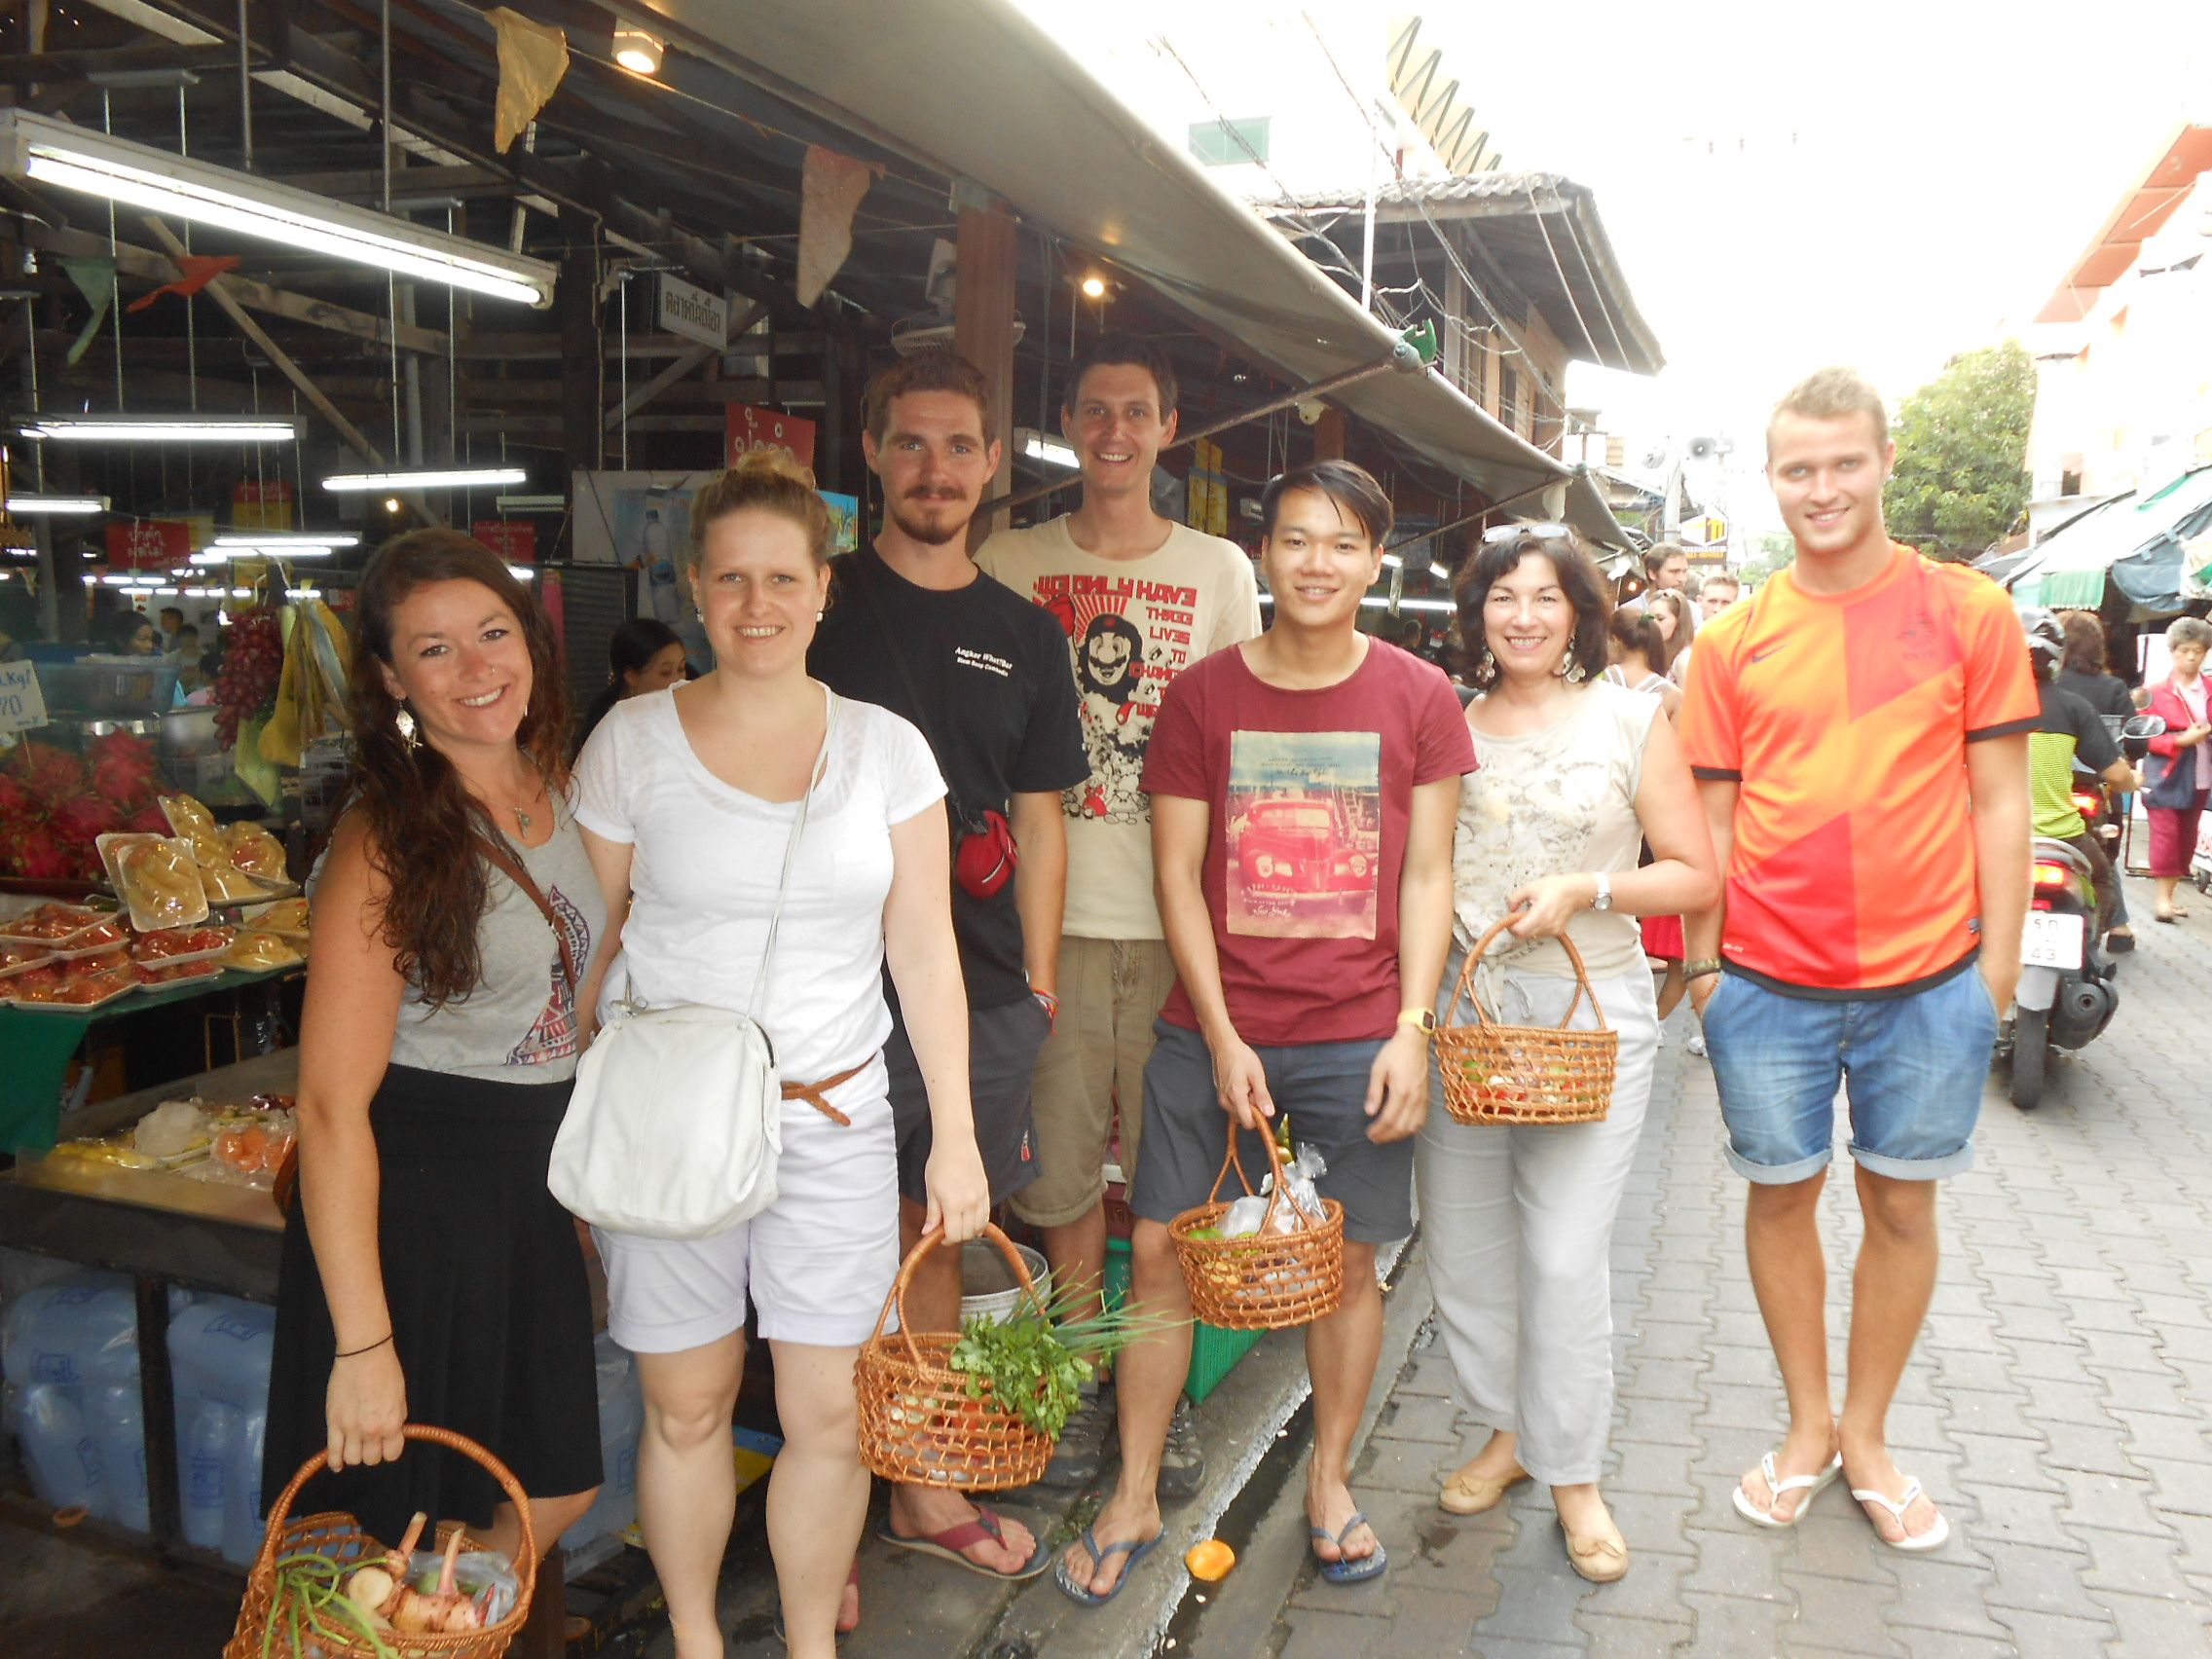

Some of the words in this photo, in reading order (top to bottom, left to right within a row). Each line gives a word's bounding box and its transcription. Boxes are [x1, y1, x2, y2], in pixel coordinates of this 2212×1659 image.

[1036, 574, 1070, 597] WE
[1072, 575, 1134, 598] ONLY
[1136, 579, 1197, 608] HAVE
[1146, 606, 1194, 626] THREE
[1149, 626, 1191, 645] LIVES
[1171, 648, 1186, 664] TO
